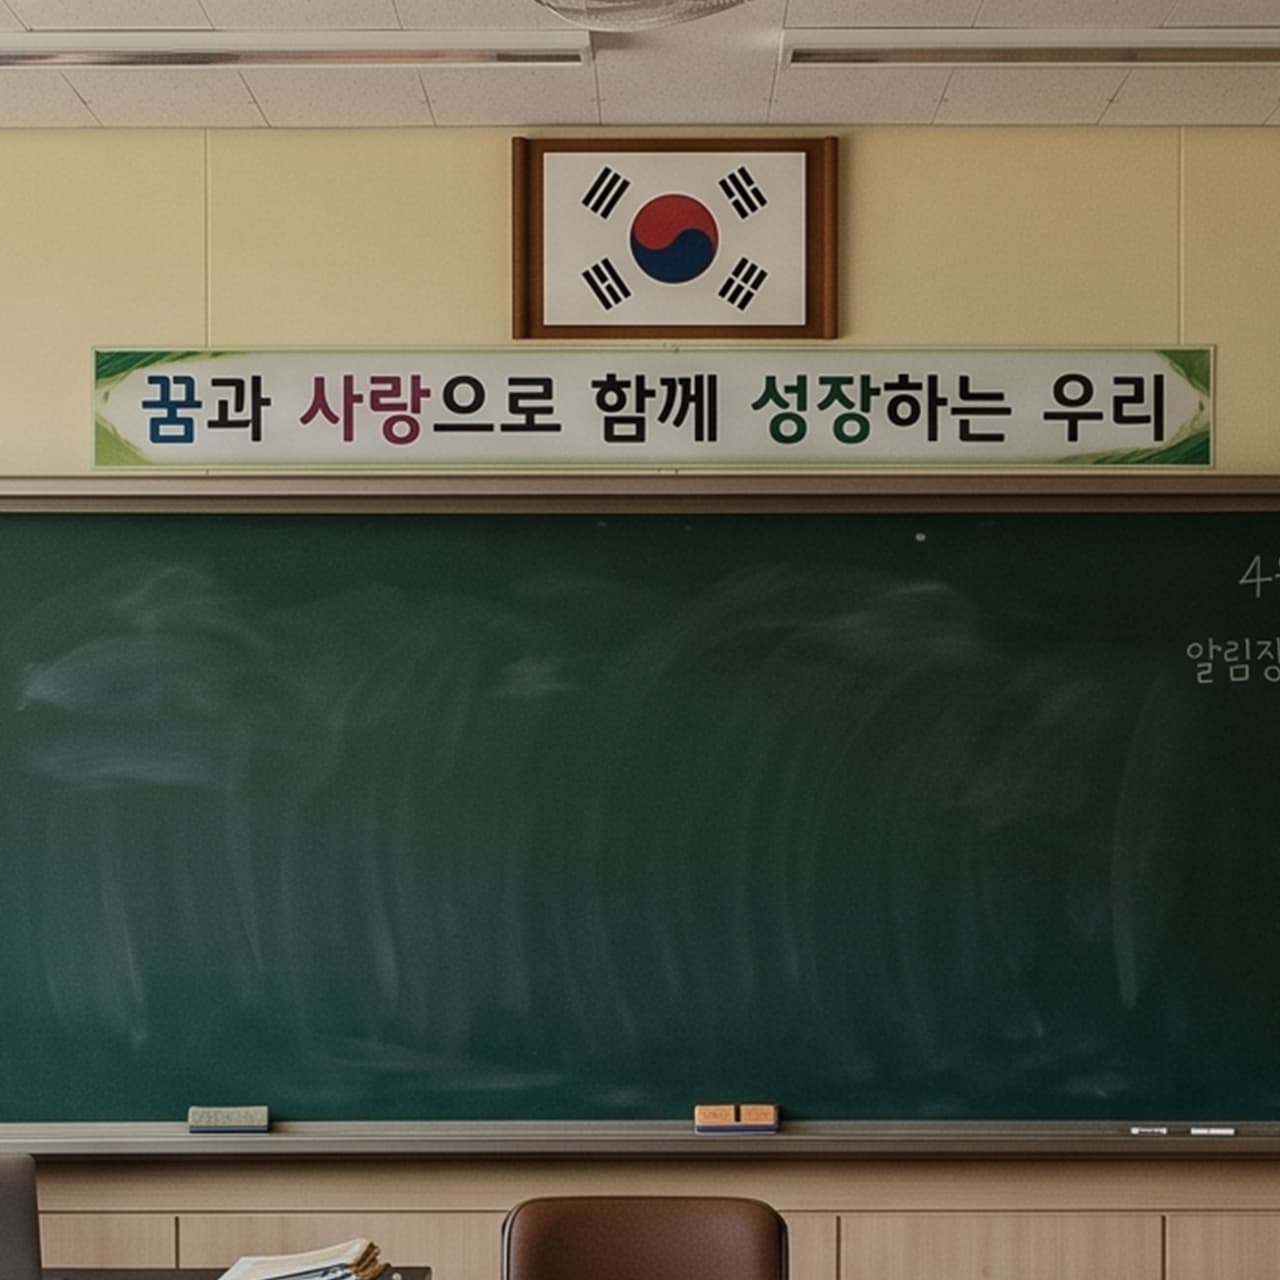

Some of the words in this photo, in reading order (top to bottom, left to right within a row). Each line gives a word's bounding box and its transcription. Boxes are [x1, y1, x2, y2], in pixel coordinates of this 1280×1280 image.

[140, 373, 272, 445] 꿈과
[298, 372, 563, 445] 사랑으로
[590, 372, 719, 444] 함께
[750, 372, 1013, 445] 성장하는
[1041, 373, 1168, 444] 우리
